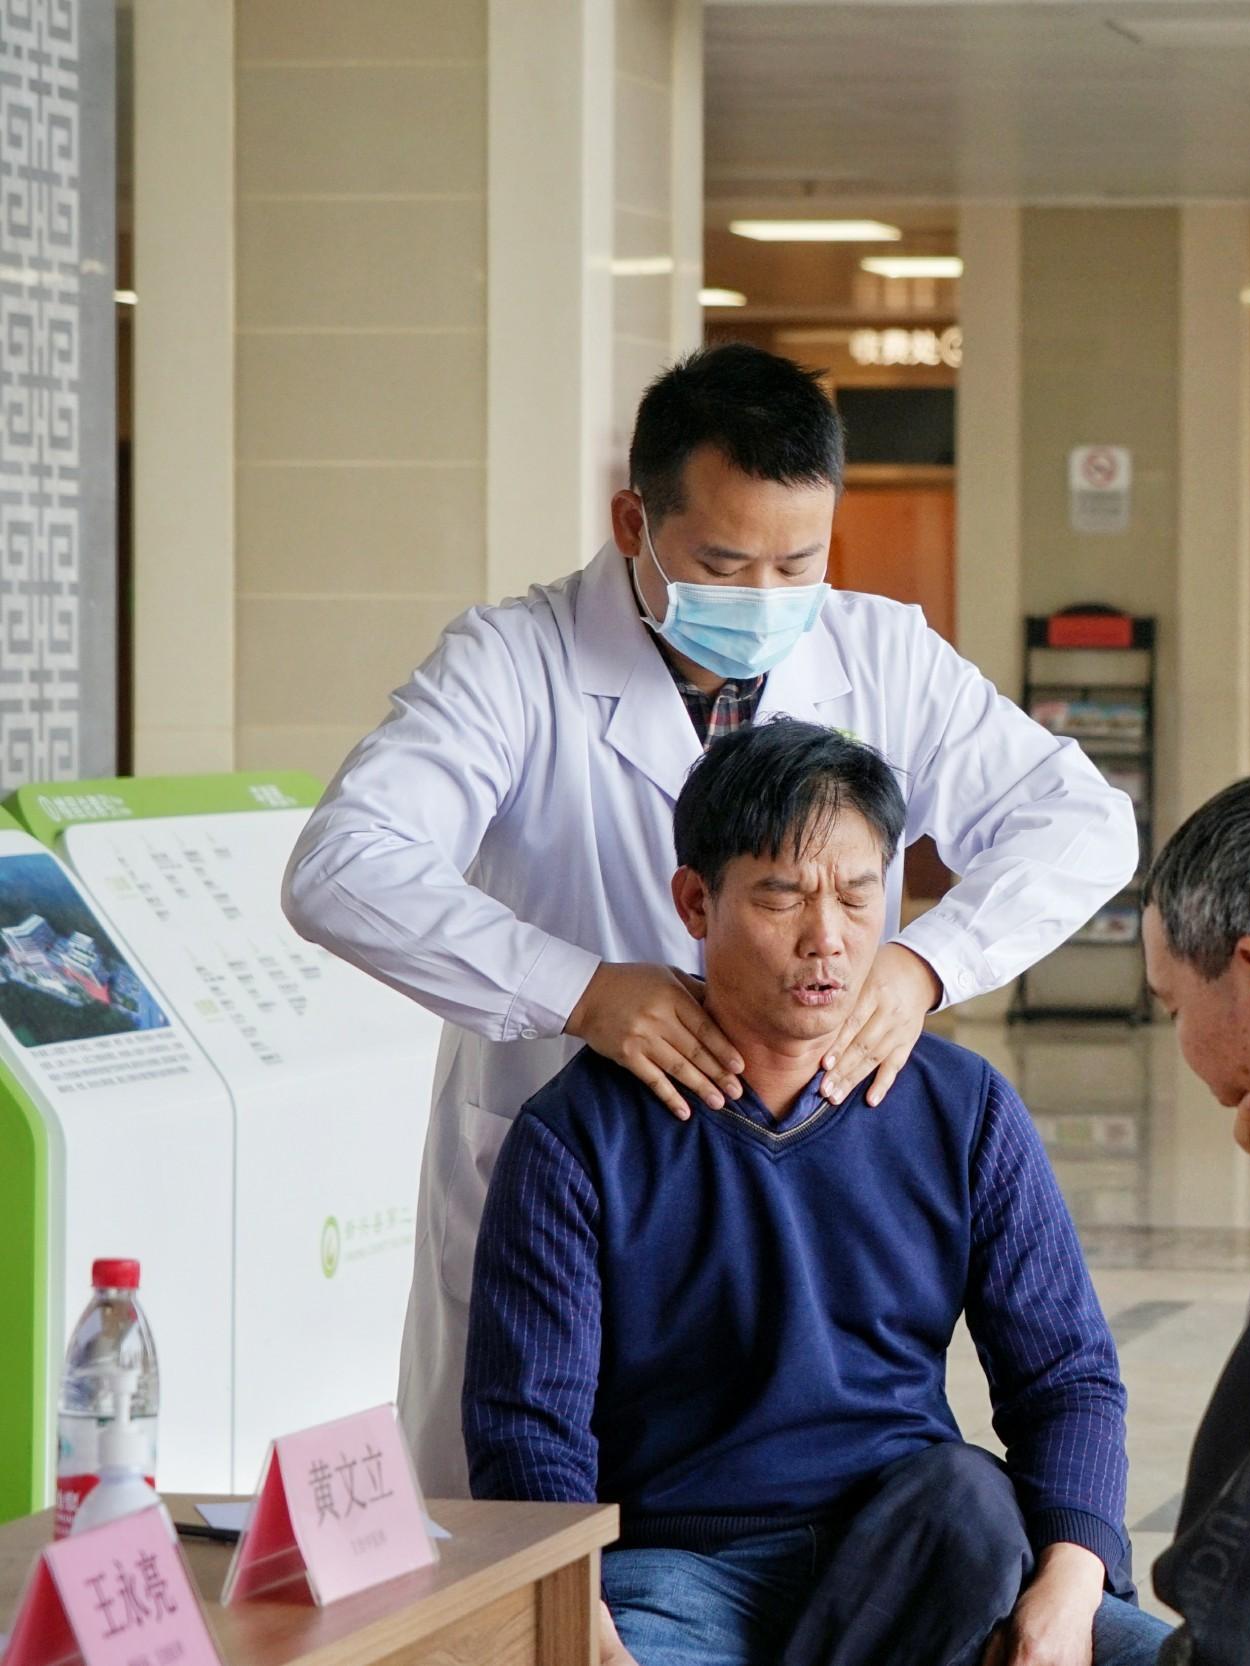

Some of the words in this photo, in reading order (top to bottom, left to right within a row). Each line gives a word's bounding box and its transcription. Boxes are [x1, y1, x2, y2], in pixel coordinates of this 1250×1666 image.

[308, 1443, 394, 1528] 黄文立
[84, 1550, 178, 1640] 王永亮
